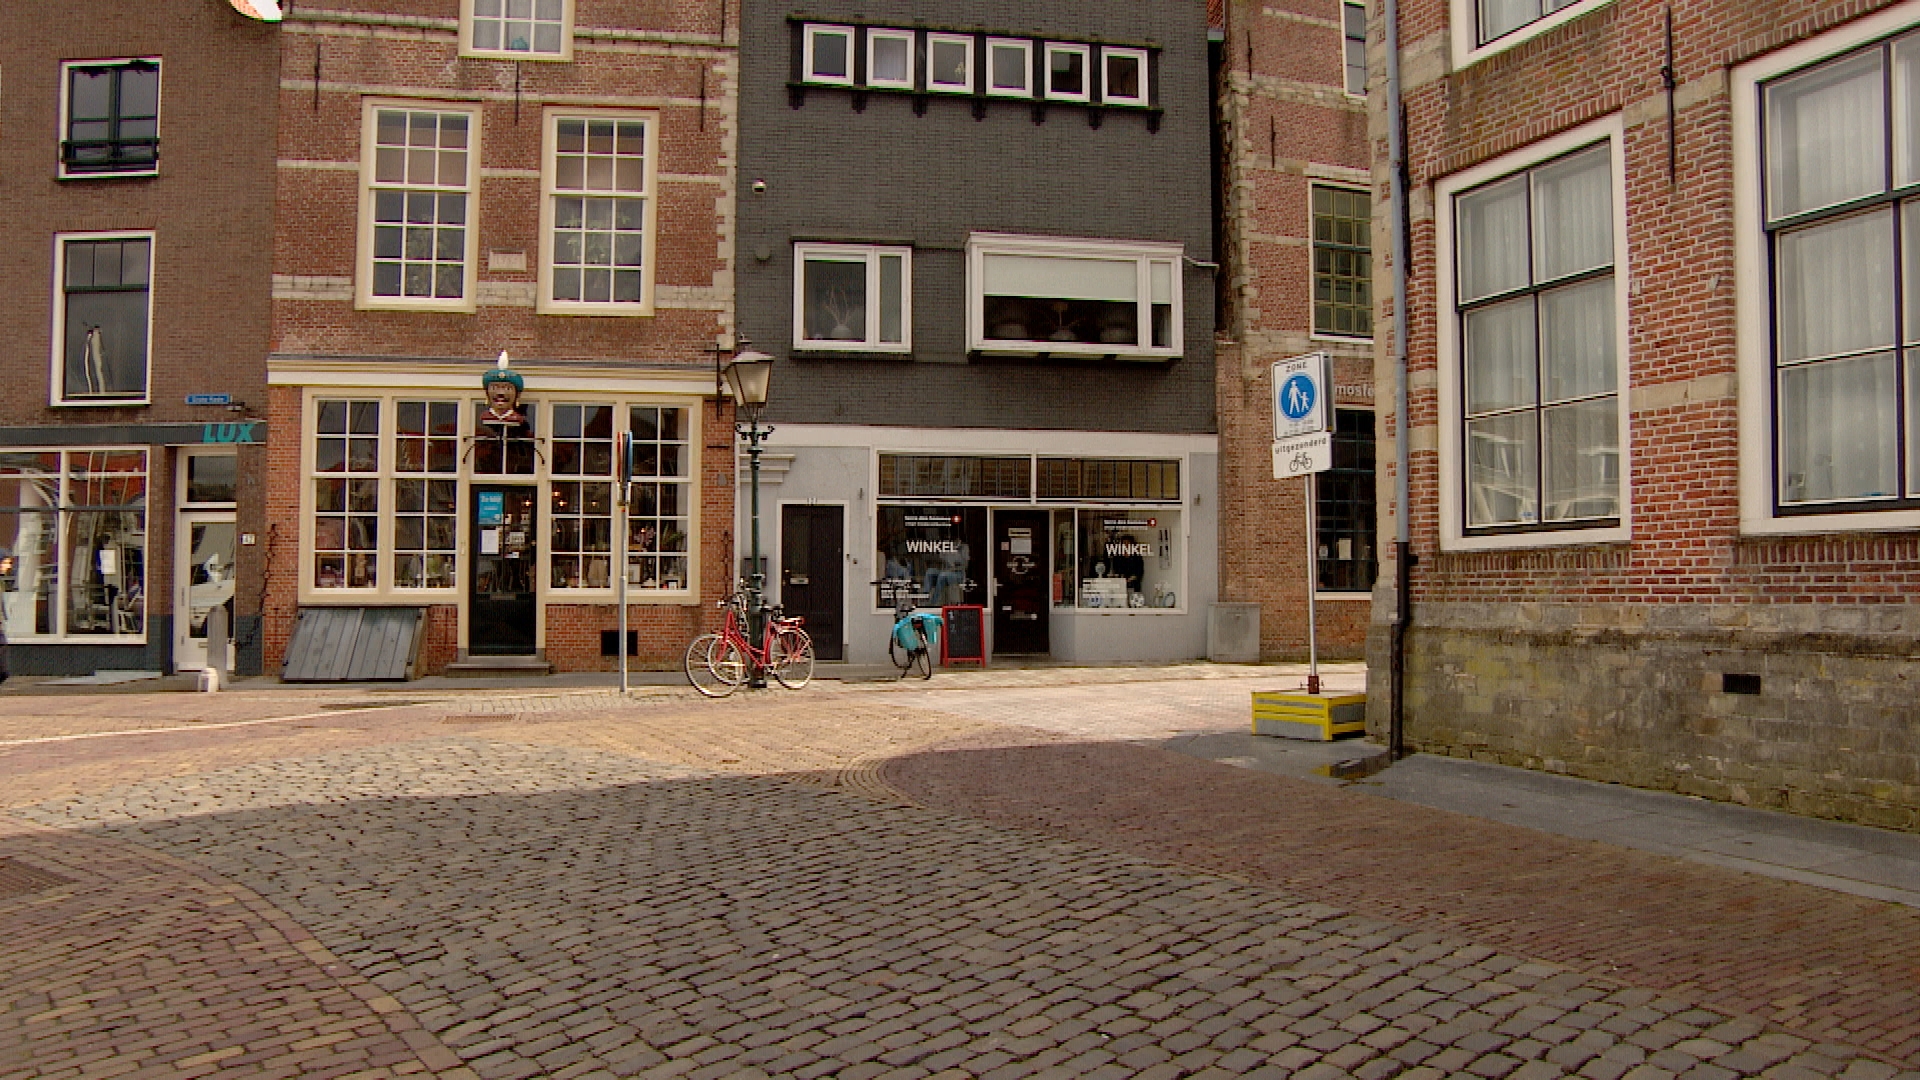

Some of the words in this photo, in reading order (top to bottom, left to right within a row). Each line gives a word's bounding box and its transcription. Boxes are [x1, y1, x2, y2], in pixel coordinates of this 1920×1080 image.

[1286, 361, 1308, 373] ZONE
[203, 423, 255, 443] LUX
[1275, 437, 1327, 454] uitgezonderd
[906, 540, 958, 553] WINKEL
[1105, 543, 1155, 557] WINKEL
